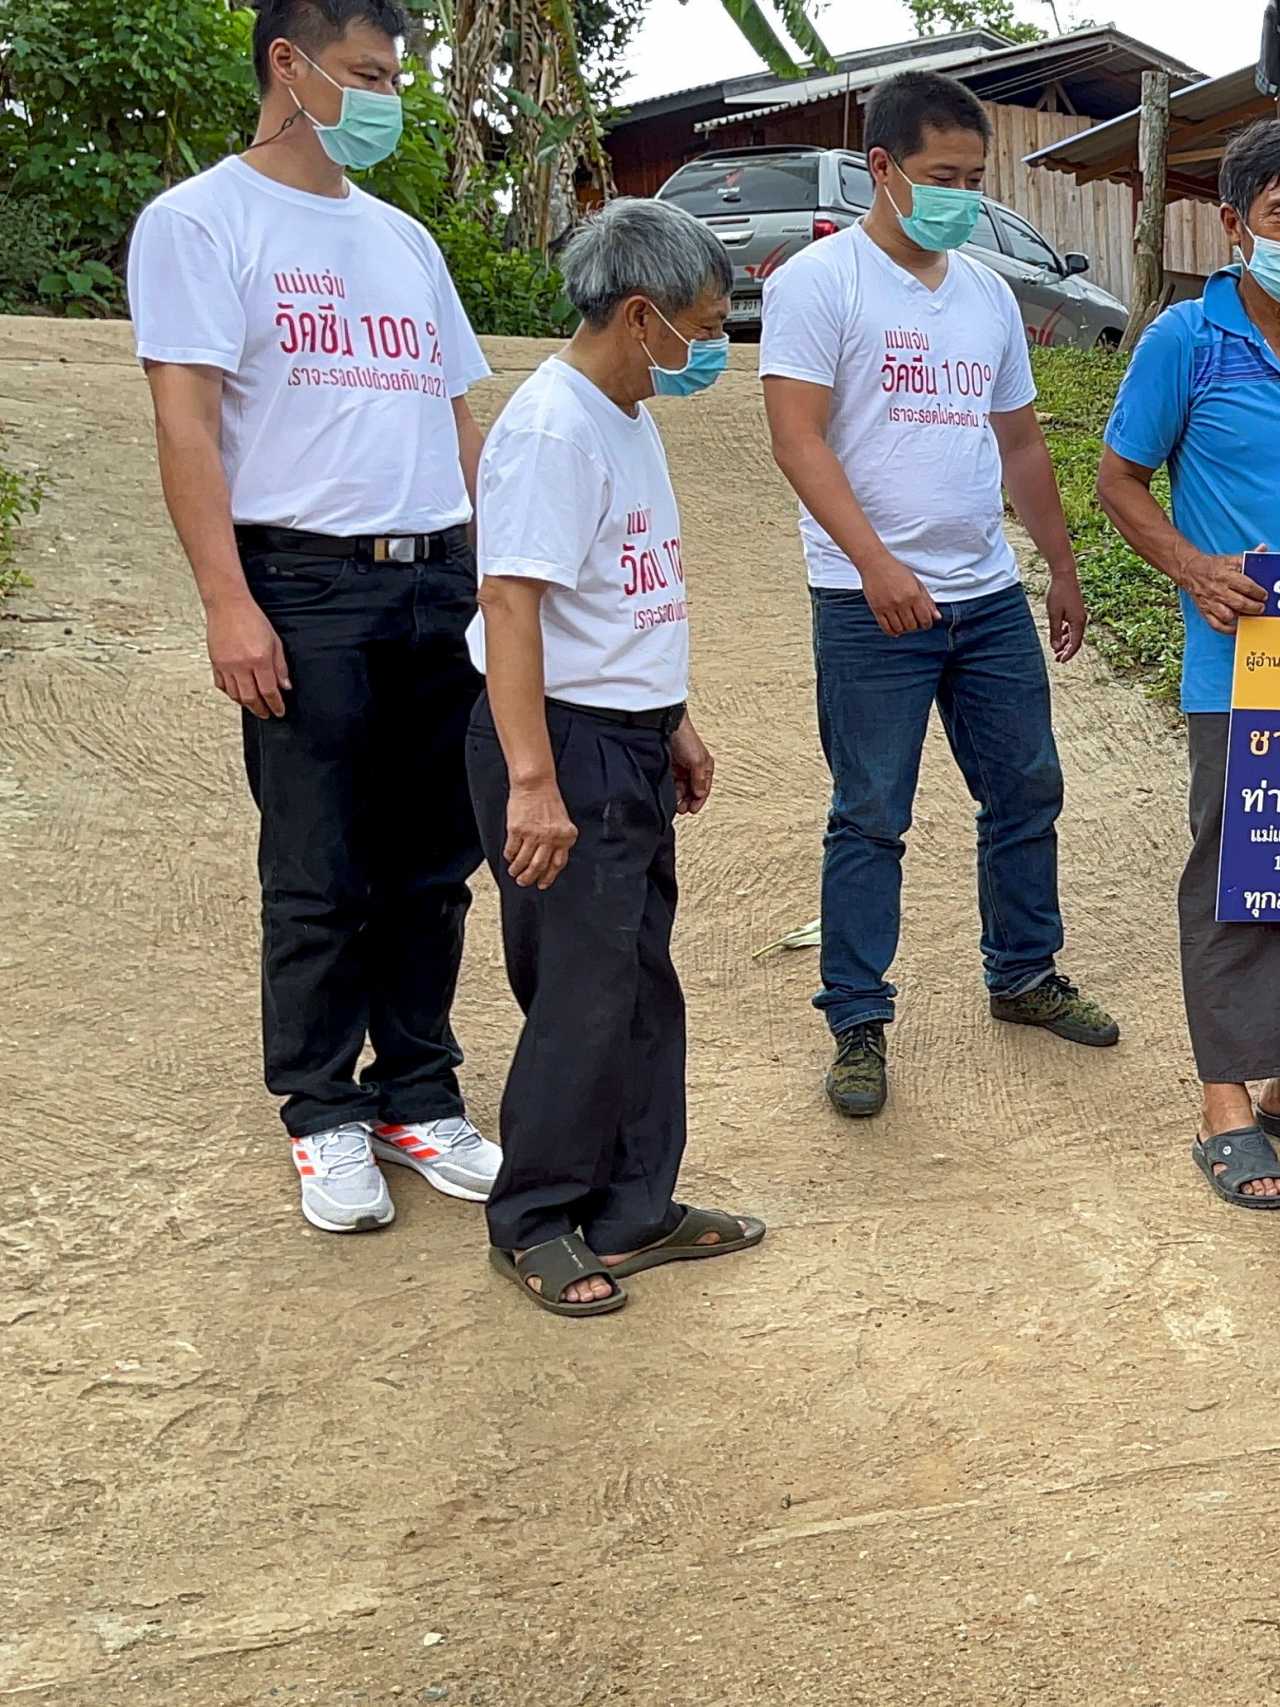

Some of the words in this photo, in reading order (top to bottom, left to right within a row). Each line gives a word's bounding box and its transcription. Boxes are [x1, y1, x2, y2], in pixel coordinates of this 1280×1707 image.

[275, 301, 354, 357] วัคซีน
[881, 354, 938, 396] วัคซีน
